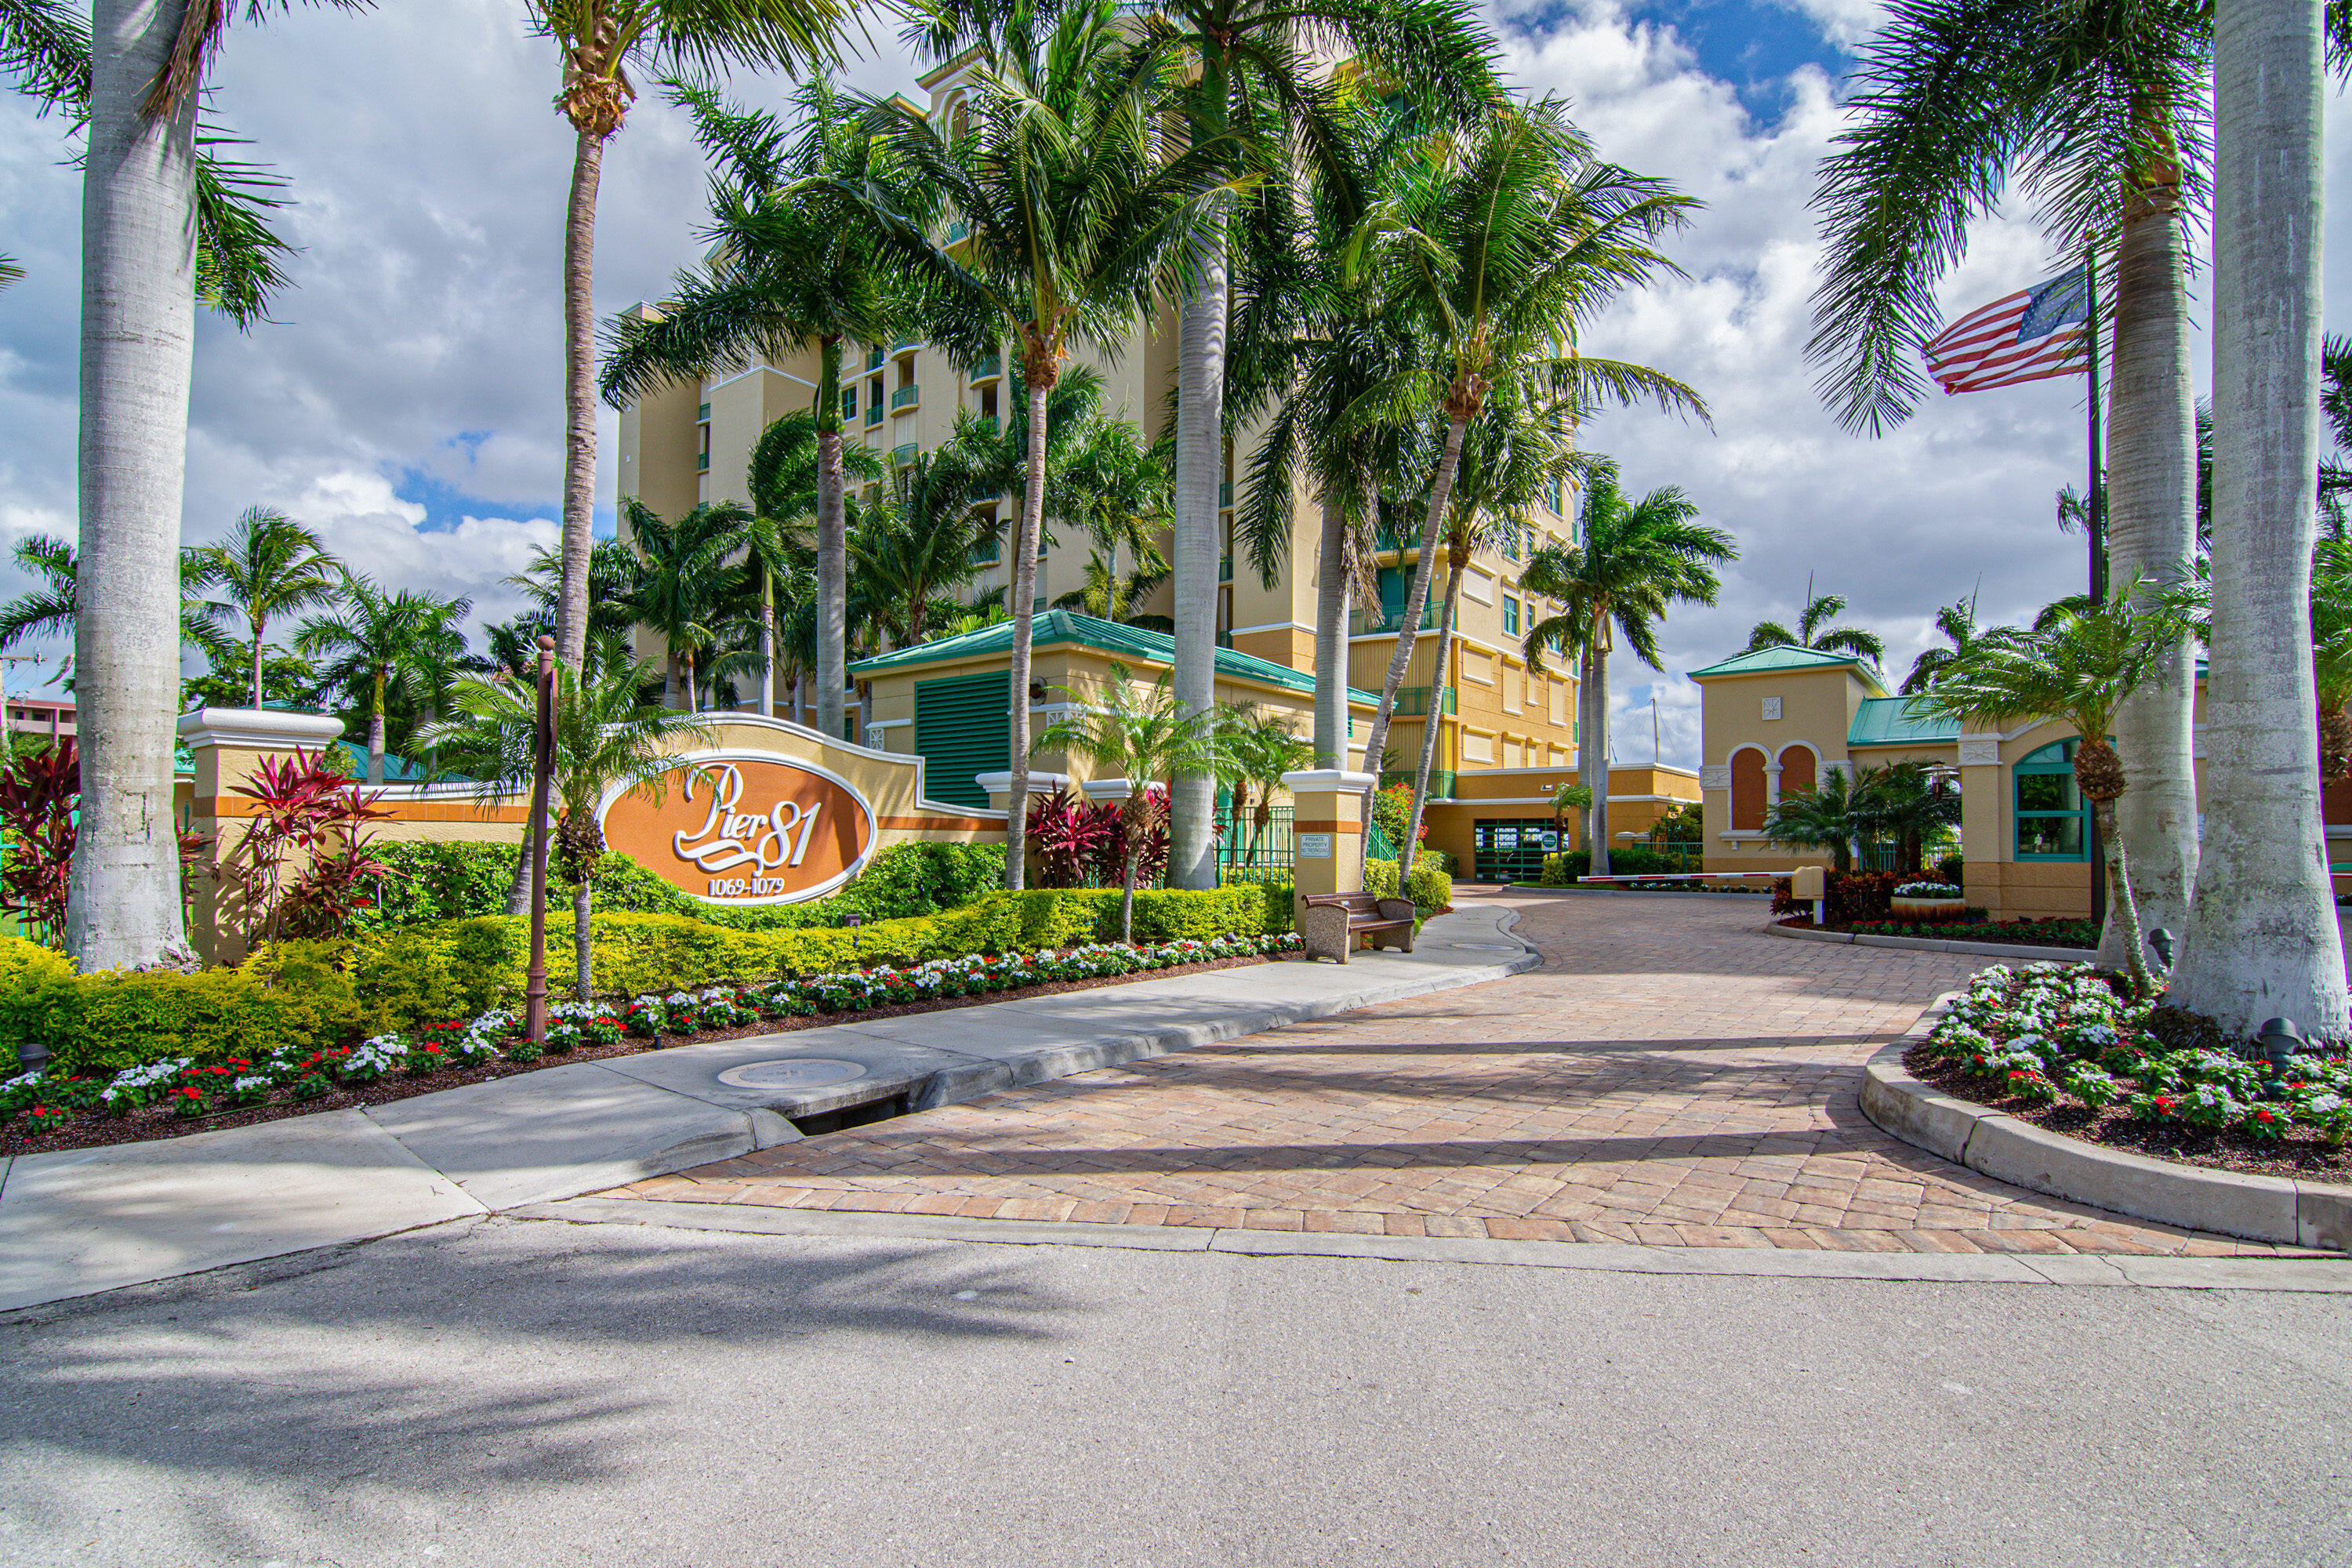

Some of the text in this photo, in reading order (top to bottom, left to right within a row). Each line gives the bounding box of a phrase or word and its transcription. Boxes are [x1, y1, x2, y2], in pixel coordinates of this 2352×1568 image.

[673, 763, 822, 877] Pier 81
[709, 878, 785, 896] 1069-1079
